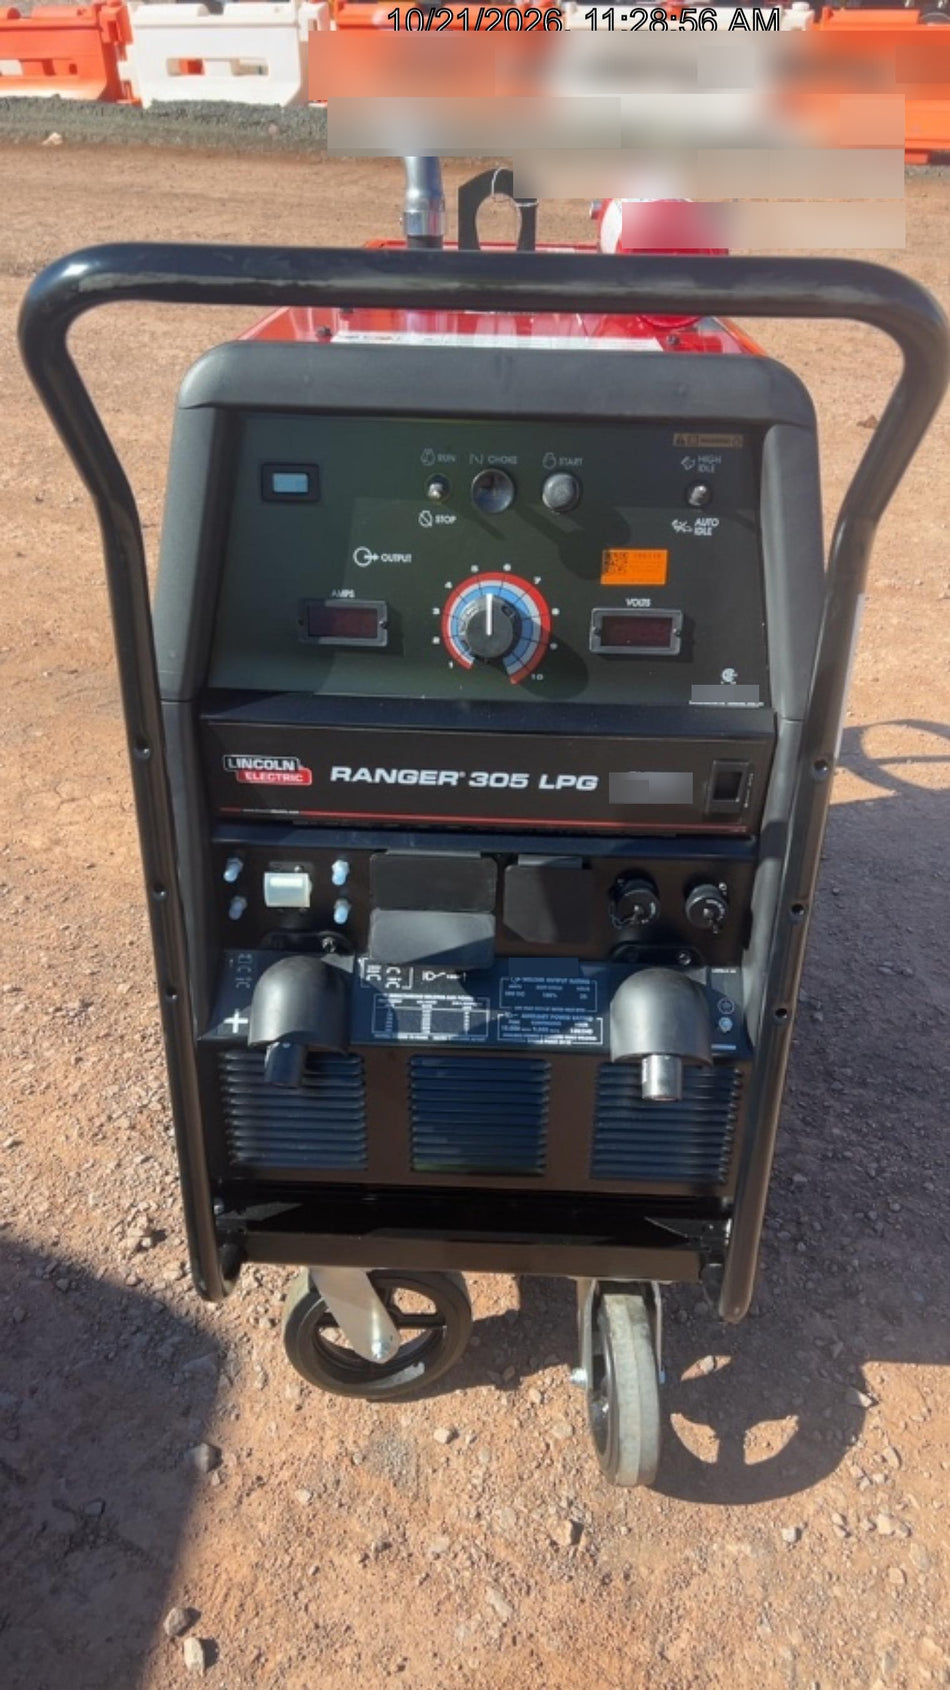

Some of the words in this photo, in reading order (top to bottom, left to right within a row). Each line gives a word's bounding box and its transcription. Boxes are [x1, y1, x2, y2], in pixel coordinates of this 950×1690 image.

[437, 453, 456, 463] RUN
[487, 455, 518, 465] CHOKE
[558, 456, 583, 466] START
[697, 455, 721, 464] HIGH
[434, 514, 457, 525] STOP
[694, 517, 720, 526] AUTO
[694, 526, 713, 536] IDLE
[381, 553, 412, 563] OUTPUT
[331, 589, 355, 598] AMPS
[625, 597, 651, 607] VOLTS
[227, 758, 295, 771] LINCOLN
[244, 772, 304, 782] ELECTRIC
[469, 771, 529, 788] 305
[538, 774, 599, 791] LPG
